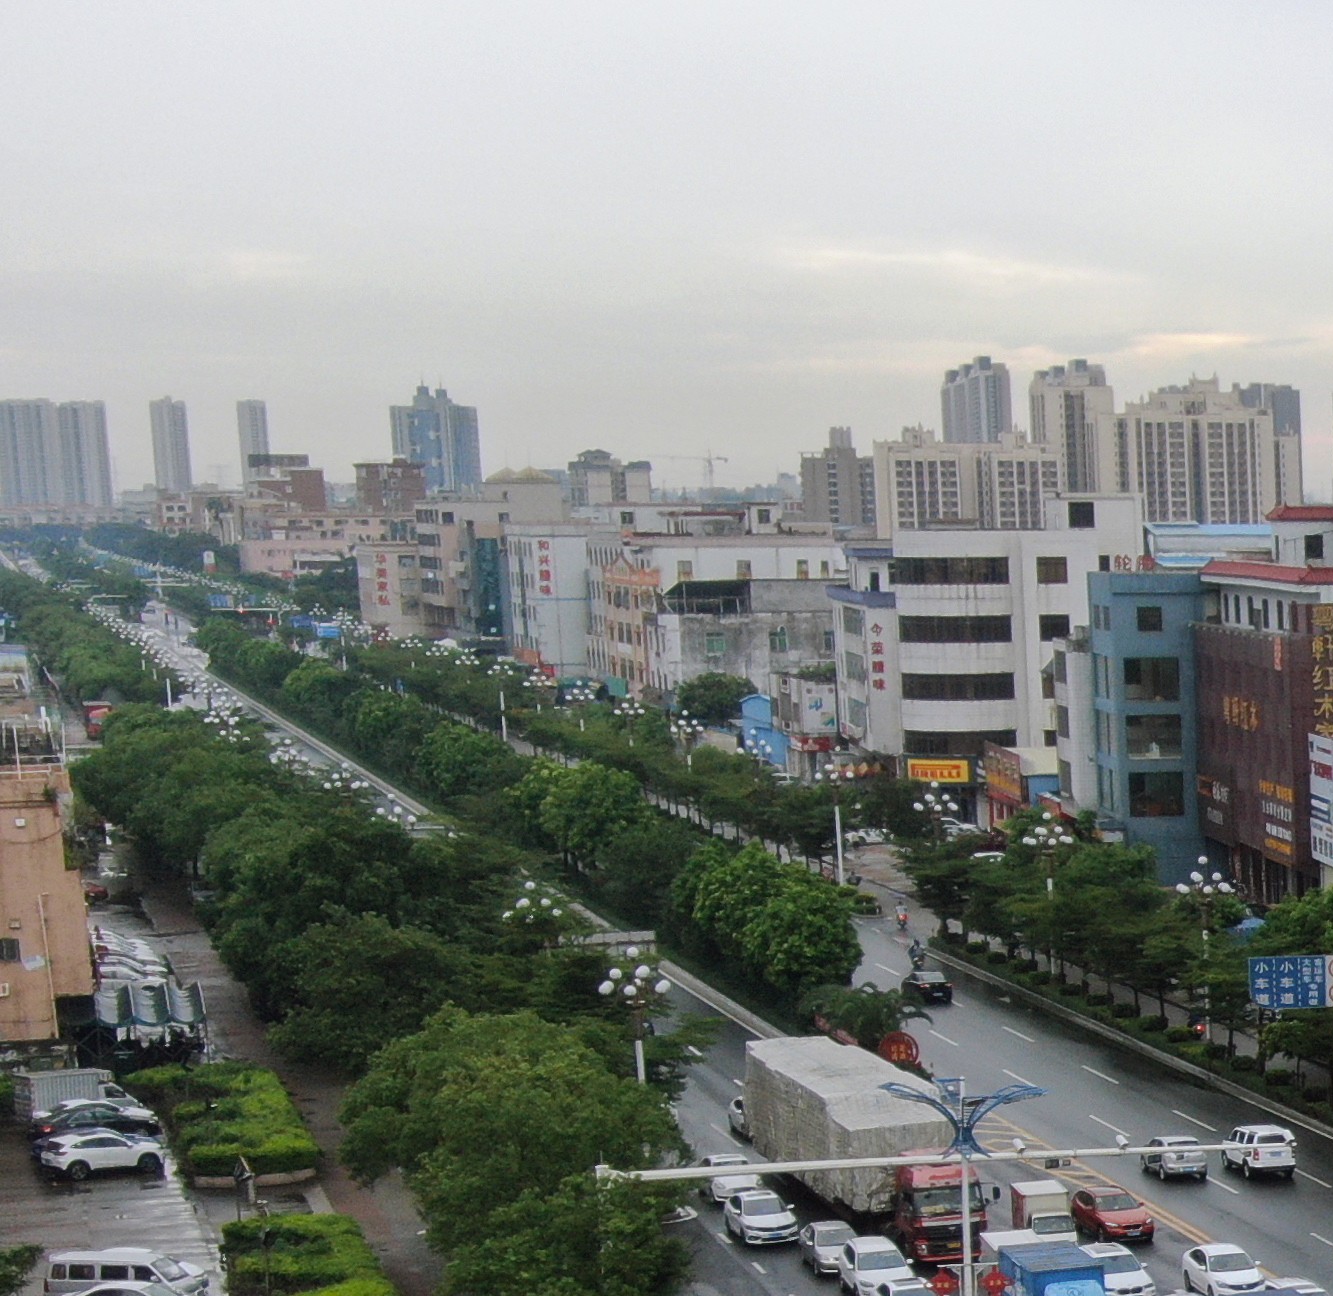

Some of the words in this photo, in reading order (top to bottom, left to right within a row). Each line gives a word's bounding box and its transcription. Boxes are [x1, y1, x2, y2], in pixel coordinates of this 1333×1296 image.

[1255, 961, 1270, 1005] 小车道
[1280, 961, 1295, 1005] 小车道
